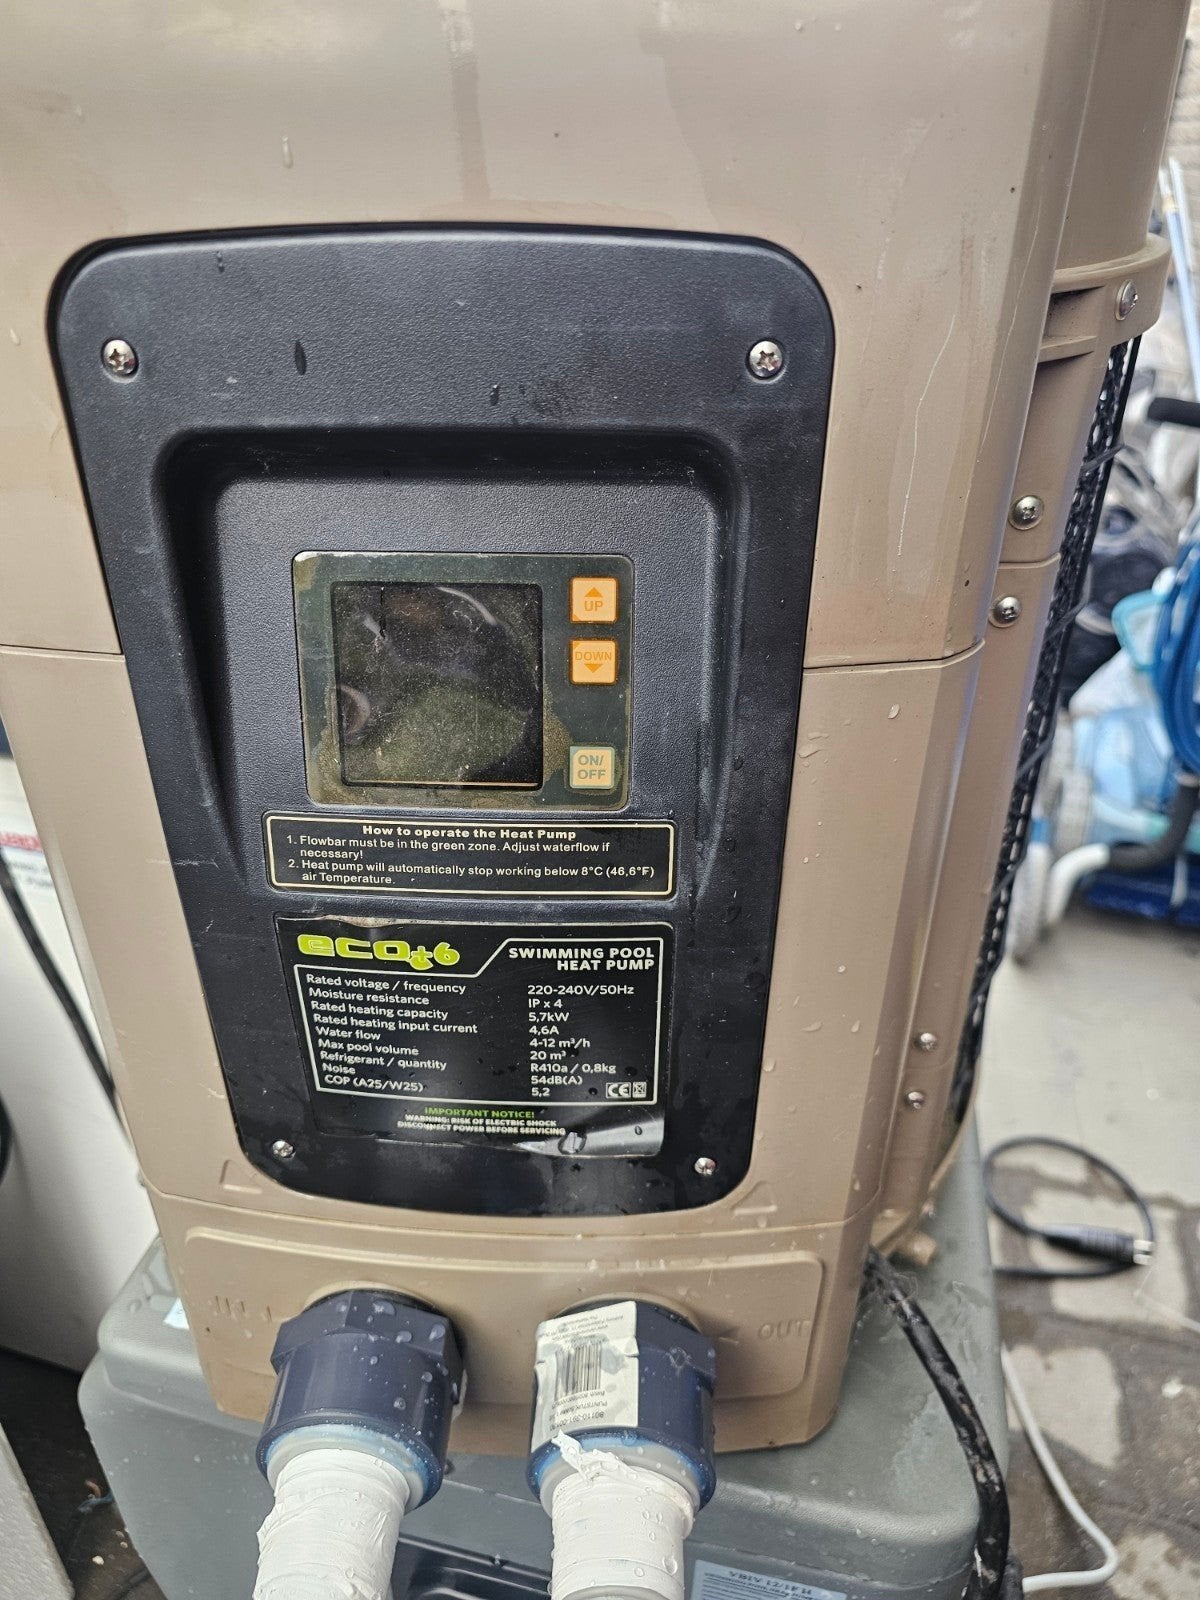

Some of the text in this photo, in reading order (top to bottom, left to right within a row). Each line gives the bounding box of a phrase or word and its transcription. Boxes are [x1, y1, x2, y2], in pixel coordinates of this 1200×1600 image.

[584, 601, 603, 611] UP
[575, 652, 612, 661] DOWN
[578, 755, 604, 765] ON/
[577, 769, 606, 779] OFF
[363, 826, 576, 841] How to operate the Heat Pump
[287, 836, 610, 853] 1. Flowbar must be in the green zone. Adjust waterflow if
[300, 849, 362, 861] necessary!
[288, 860, 654, 878] 2. Heat pump will automatically stop working below 8°C (46,6°F)
[302, 872, 395, 885] air Temperature.
[509, 948, 654, 959] SWIMMING POOL
[557, 960, 654, 971] HEAT PUMP
[307, 974, 466, 994] Rated voltage / frequency
[528, 985, 634, 996] 220-240V/50Hz
[309, 988, 430, 1005] Moisture resistance
[529, 999, 540, 1008] IP
[554, 999, 562, 1008] 4
[311, 1001, 448, 1020] Rated heating capacity
[528, 1012, 569, 1023] 5,7kW
[314, 1014, 478, 1033] Rated heating input current
[316, 1026, 380, 1040] Water flow
[529, 1026, 559, 1036] 4,6A
[318, 1039, 419, 1055] Max pool volume
[530, 1038, 590, 1049] 4-12 m³/h
[320, 1051, 447, 1071] Refrigerant / quantity
[530, 1051, 546, 1060] 20
[322, 1063, 355, 1074] Noise
[531, 1063, 616, 1074] R410a / 0,8kg
[325, 1075, 424, 1092] COP (A25/W25)
[531, 1075, 582, 1085] 54dB(A)
[532, 1087, 550, 1097] 5,2
[424, 1107, 534, 1118] IMPORTANT NOTICE!
[405, 1114, 450, 1124] WARNING:
[397, 1121, 451, 1131] DISCONNECT
[520, 1127, 566, 1135] SERVICING
[759, 1320, 811, 1339] OUT
